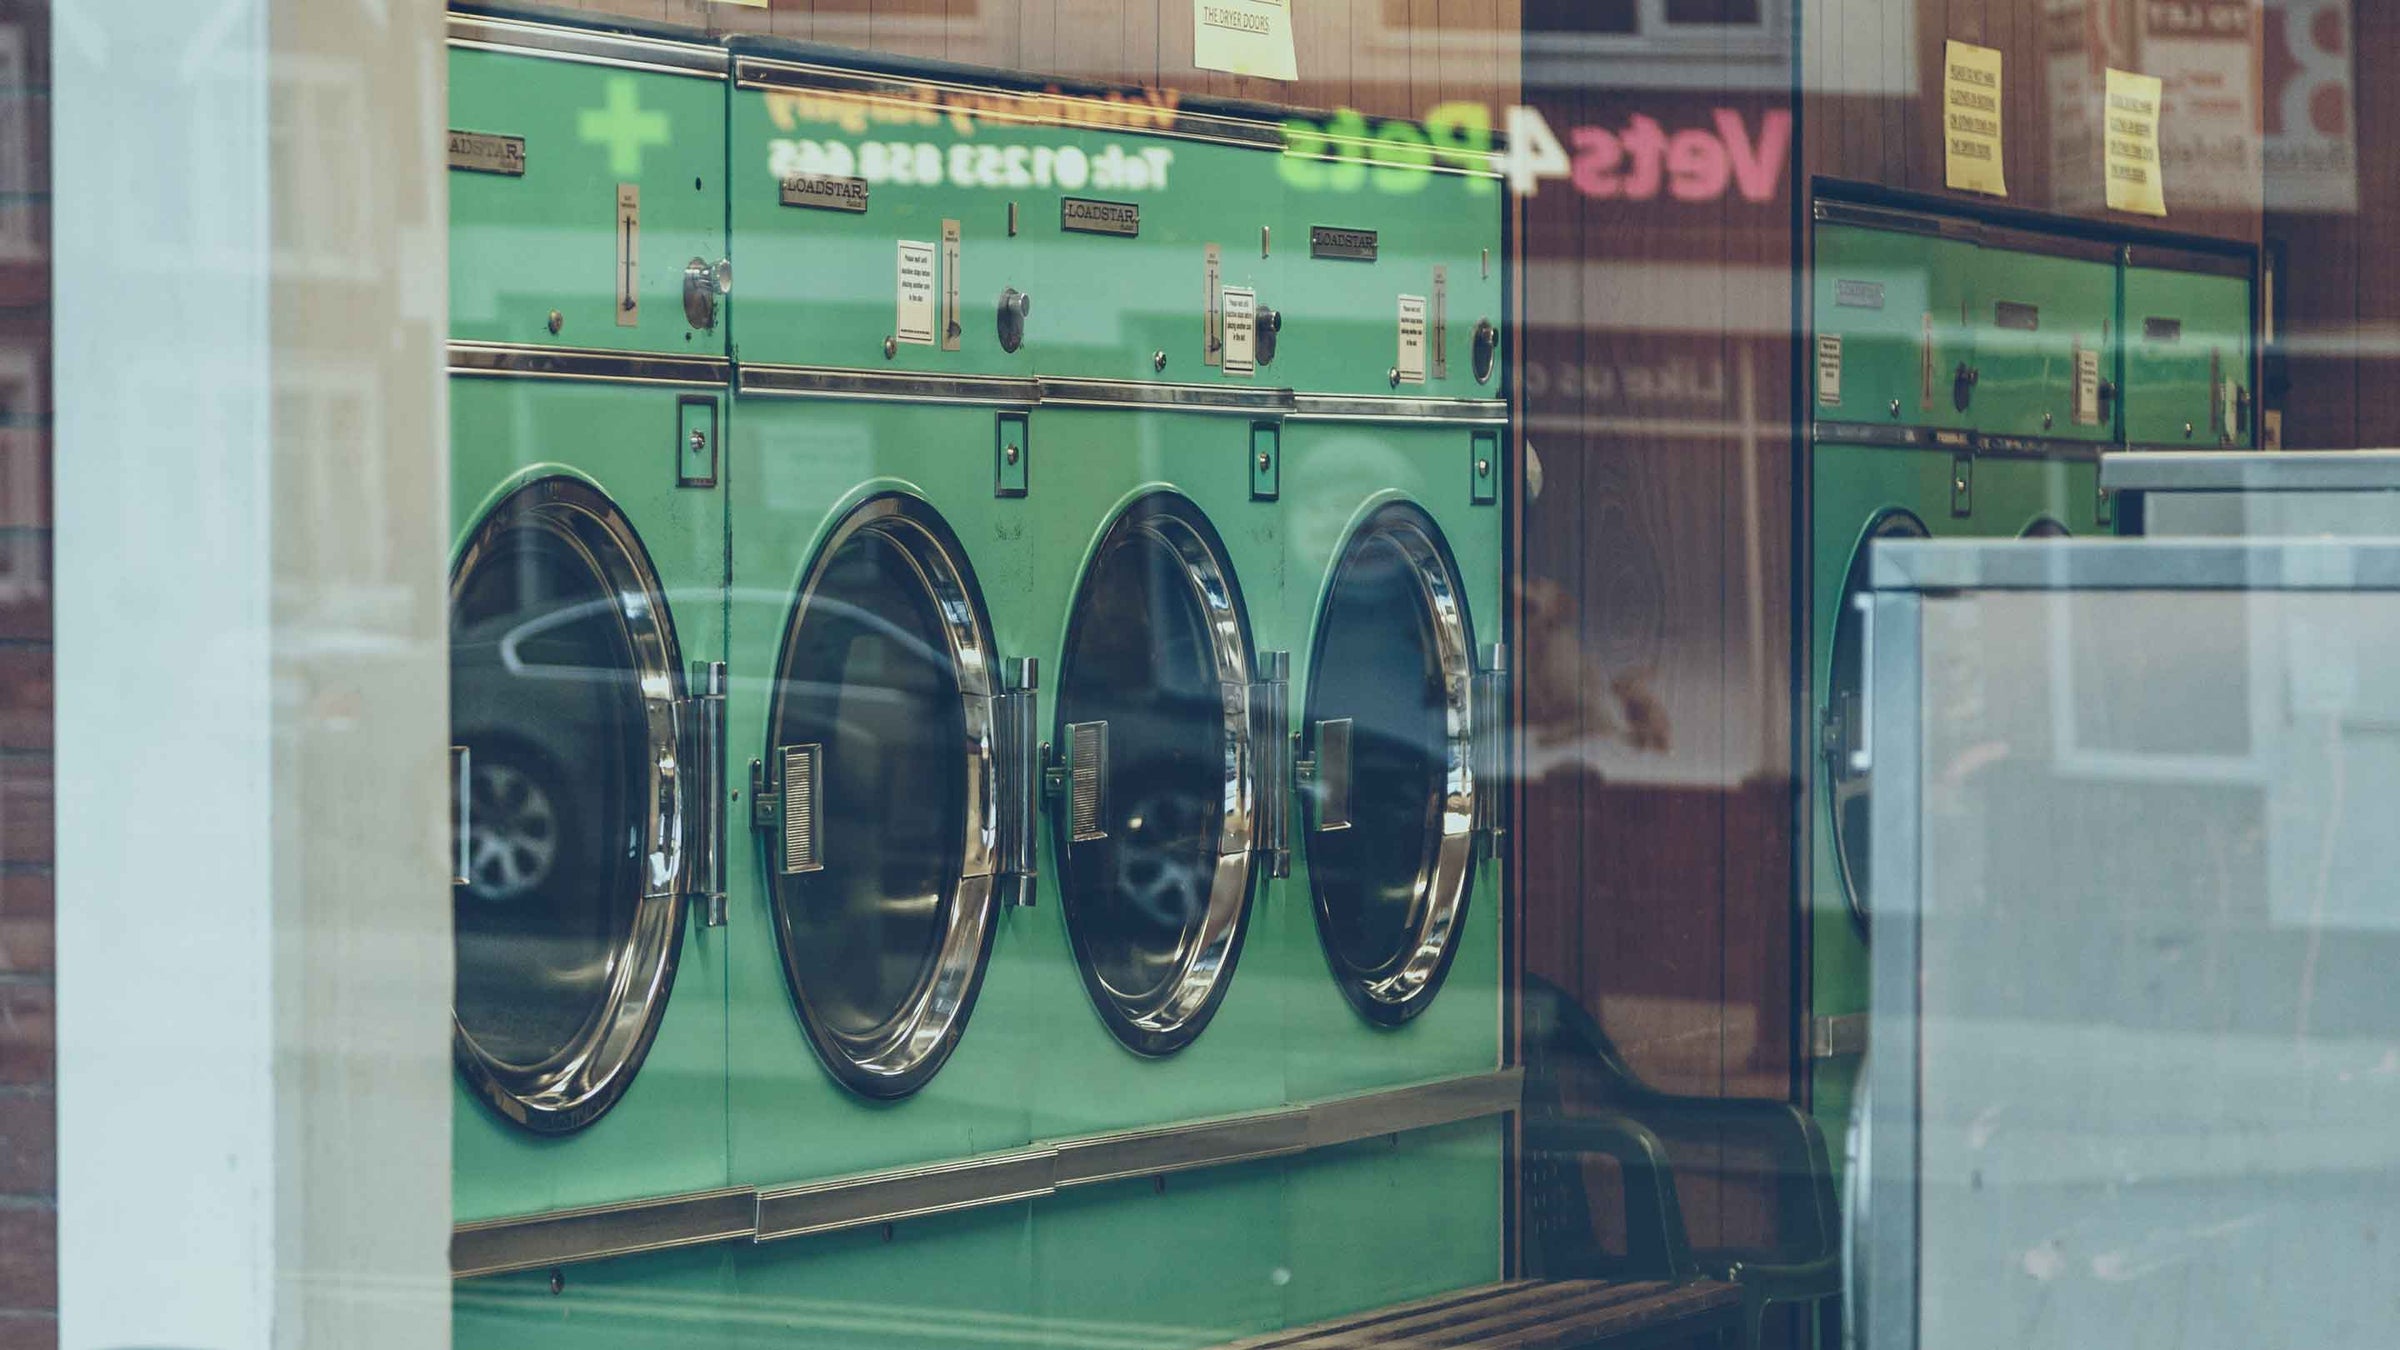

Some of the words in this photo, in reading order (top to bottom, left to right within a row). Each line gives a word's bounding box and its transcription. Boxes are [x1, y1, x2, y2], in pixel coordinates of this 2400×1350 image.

[1203, 6, 1218, 24] THE
[1219, 9, 1242, 27] DRYER
[1243, 13, 1270, 32] DOORS
[449, 138, 521, 160] ADSTAR
[786, 178, 865, 200] LOADSTAR
[1067, 203, 1136, 224] LOADSTAR
[1316, 232, 1375, 249] LOADSTAR
